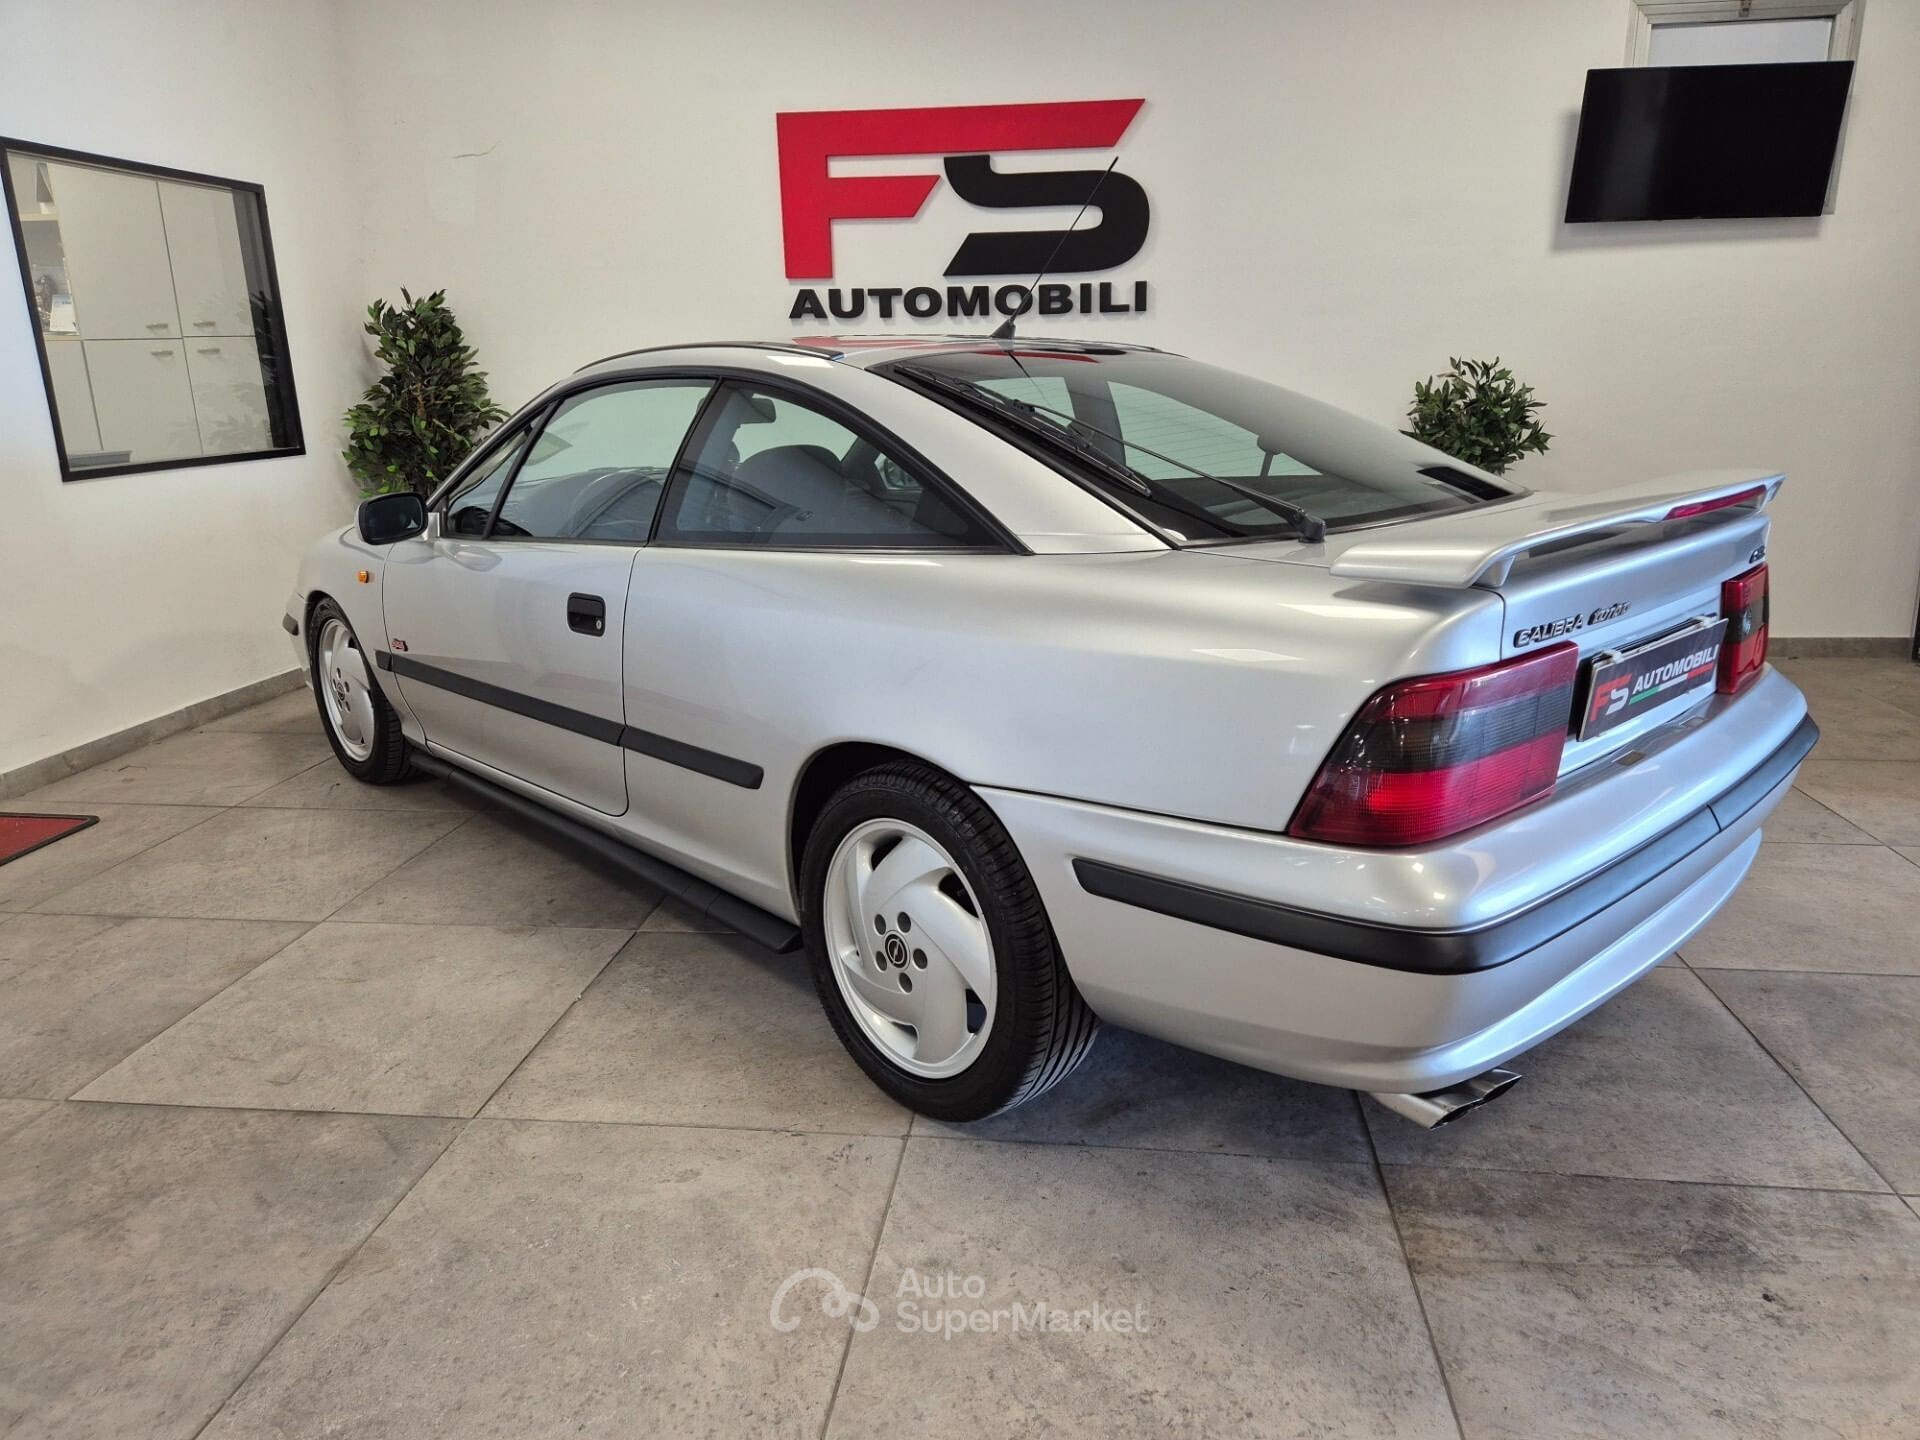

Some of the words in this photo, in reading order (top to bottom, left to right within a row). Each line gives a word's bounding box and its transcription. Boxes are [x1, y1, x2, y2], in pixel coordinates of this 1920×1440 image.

[776, 98, 1150, 279] FS
[789, 281, 1148, 319] AUTOMOBILI
[1513, 613, 1584, 648] CALIBRA
[1590, 674, 1632, 720] FS
[1632, 644, 1719, 693] AUTOMOBILI
